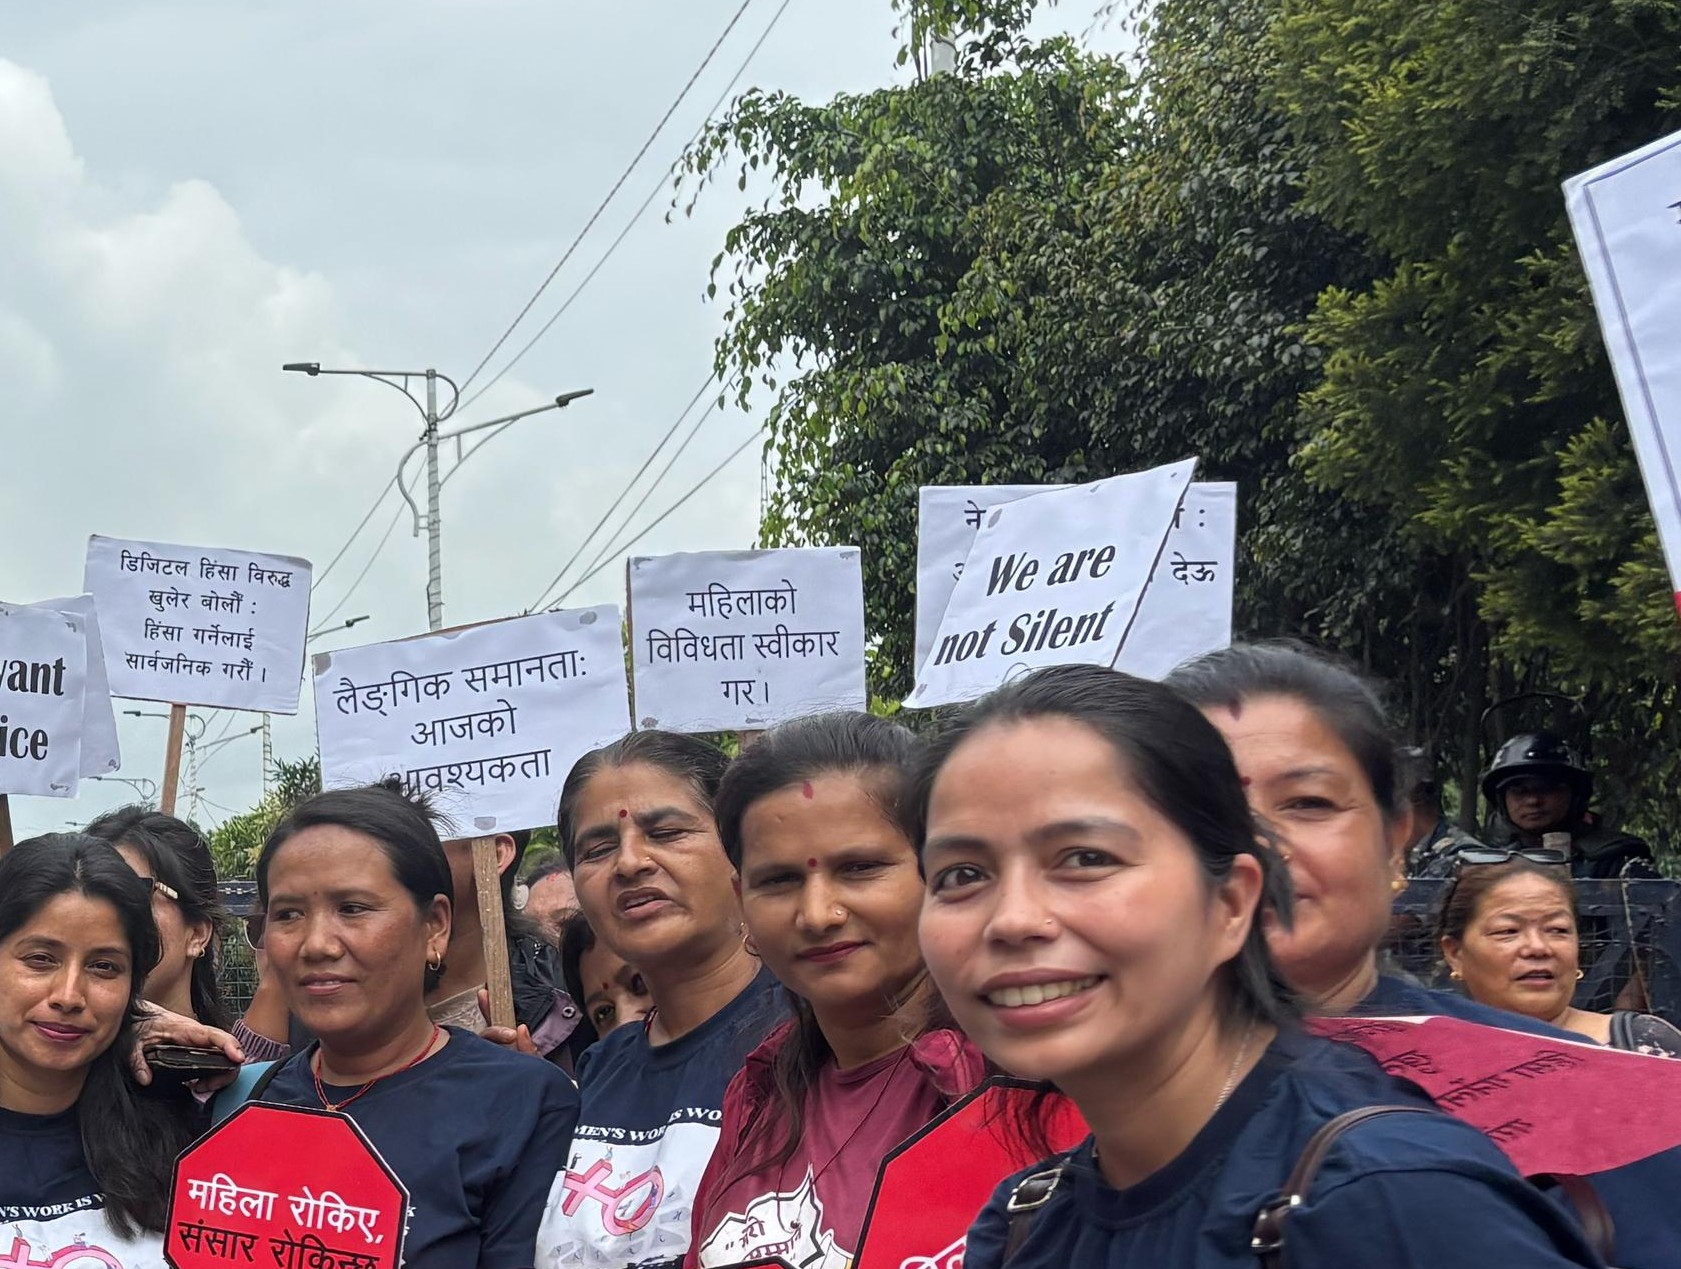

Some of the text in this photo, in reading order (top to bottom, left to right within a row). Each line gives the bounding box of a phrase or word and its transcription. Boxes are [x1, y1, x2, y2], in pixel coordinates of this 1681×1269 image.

[120, 550, 293, 588] डिजिटल हिंसा विरुद्ध
[986, 551, 1039, 597] We
[1046, 544, 1116, 587] are
[1170, 551, 1218, 585] देऊ
[149, 586, 191, 612] खुलेर
[201, 590, 243, 614] बोलौं
[686, 579, 797, 620] महिलाको
[144, 618, 255, 651] हिंसा गर्नेलाई
[646, 626, 840, 664] विविधता स्वीकार
[933, 600, 1116, 666] not Silent
[125, 651, 213, 676] सार्वजनिक
[462, 649, 587, 693] समानता:
[410, 698, 519, 749] आजको
[574, 1125, 626, 1139] MEN'S
[629, 1125, 667, 1141] WOR
[21, 1202, 75, 1217] WORK
[75, 1195, 93, 1209] IS
[187, 1173, 384, 1245] महिला रोकिए,
[177, 1218, 259, 1263] संसार
